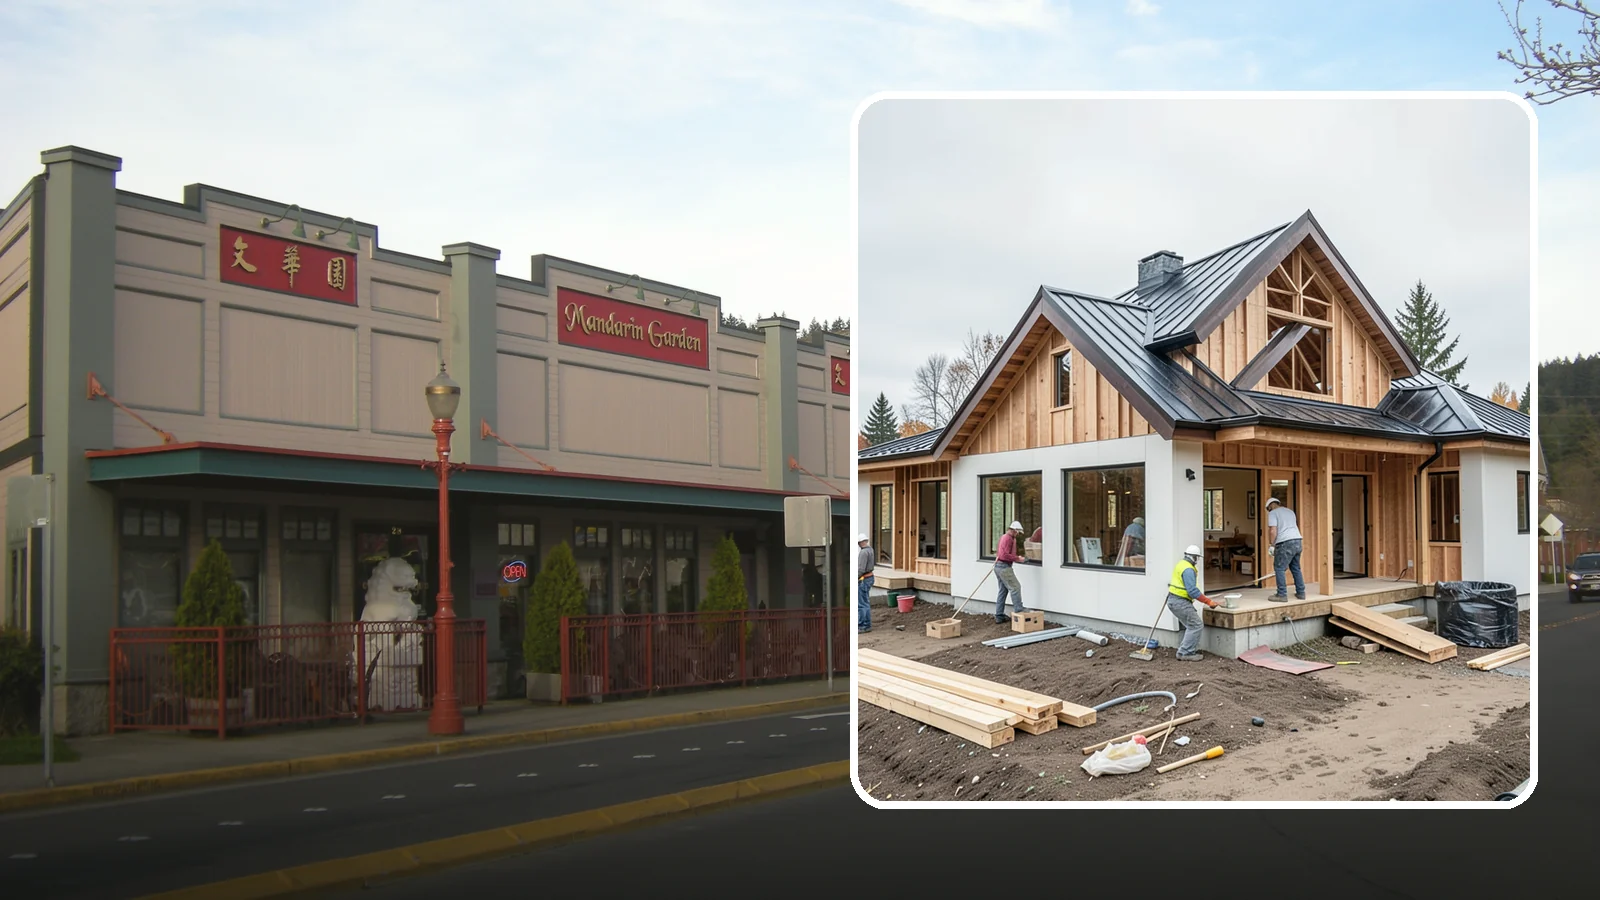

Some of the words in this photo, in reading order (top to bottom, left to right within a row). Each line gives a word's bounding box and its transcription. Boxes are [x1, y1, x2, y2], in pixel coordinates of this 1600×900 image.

[231, 235, 346, 290] 文華園
[564, 302, 644, 341] Mandarin
[648, 320, 701, 352] Garden
[503, 565, 527, 578] OPEN
